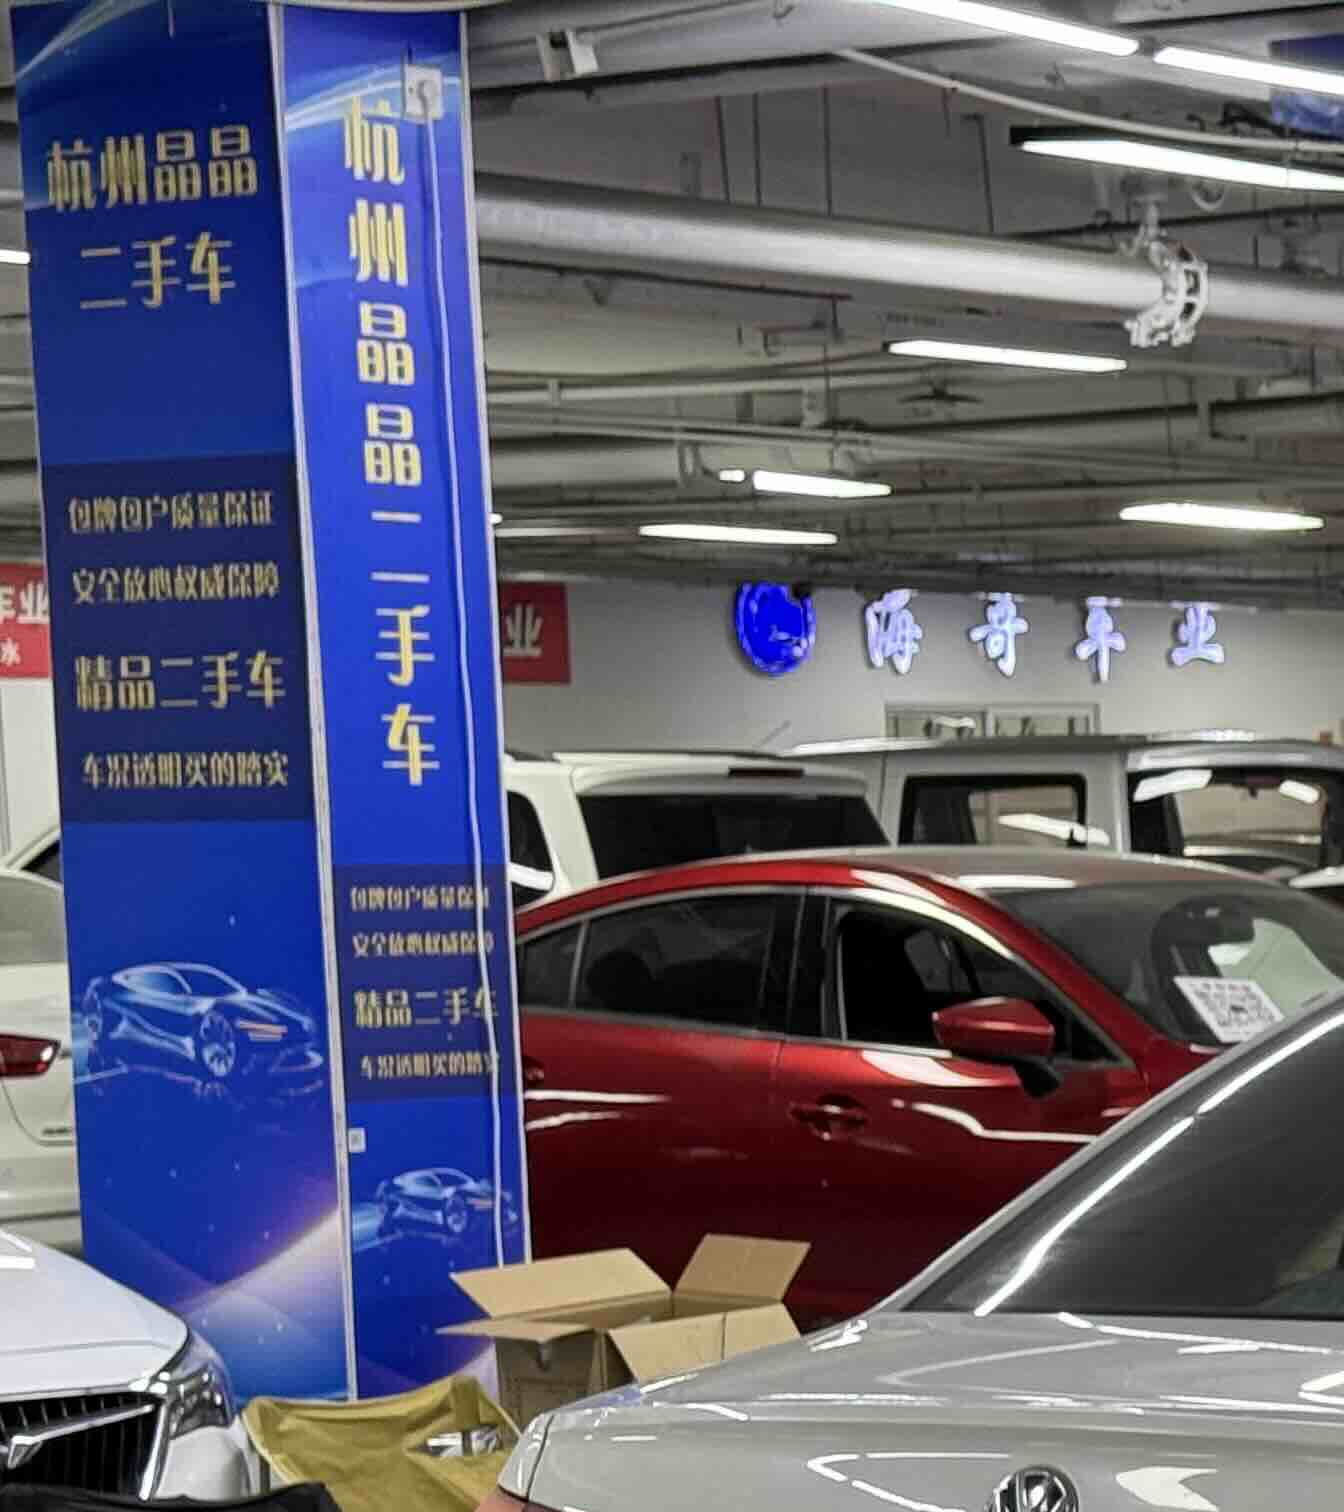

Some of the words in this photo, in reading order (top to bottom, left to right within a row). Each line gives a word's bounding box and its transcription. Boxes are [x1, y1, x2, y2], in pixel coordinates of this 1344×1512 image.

[46, 126, 258, 213] 杭州晶晶
[80, 231, 237, 310] 二手车
[342, 96, 440, 785] 杭州晶晶二手车
[72, 561, 280, 604] 安全放心权威保障
[75, 650, 286, 711] 精品二手车
